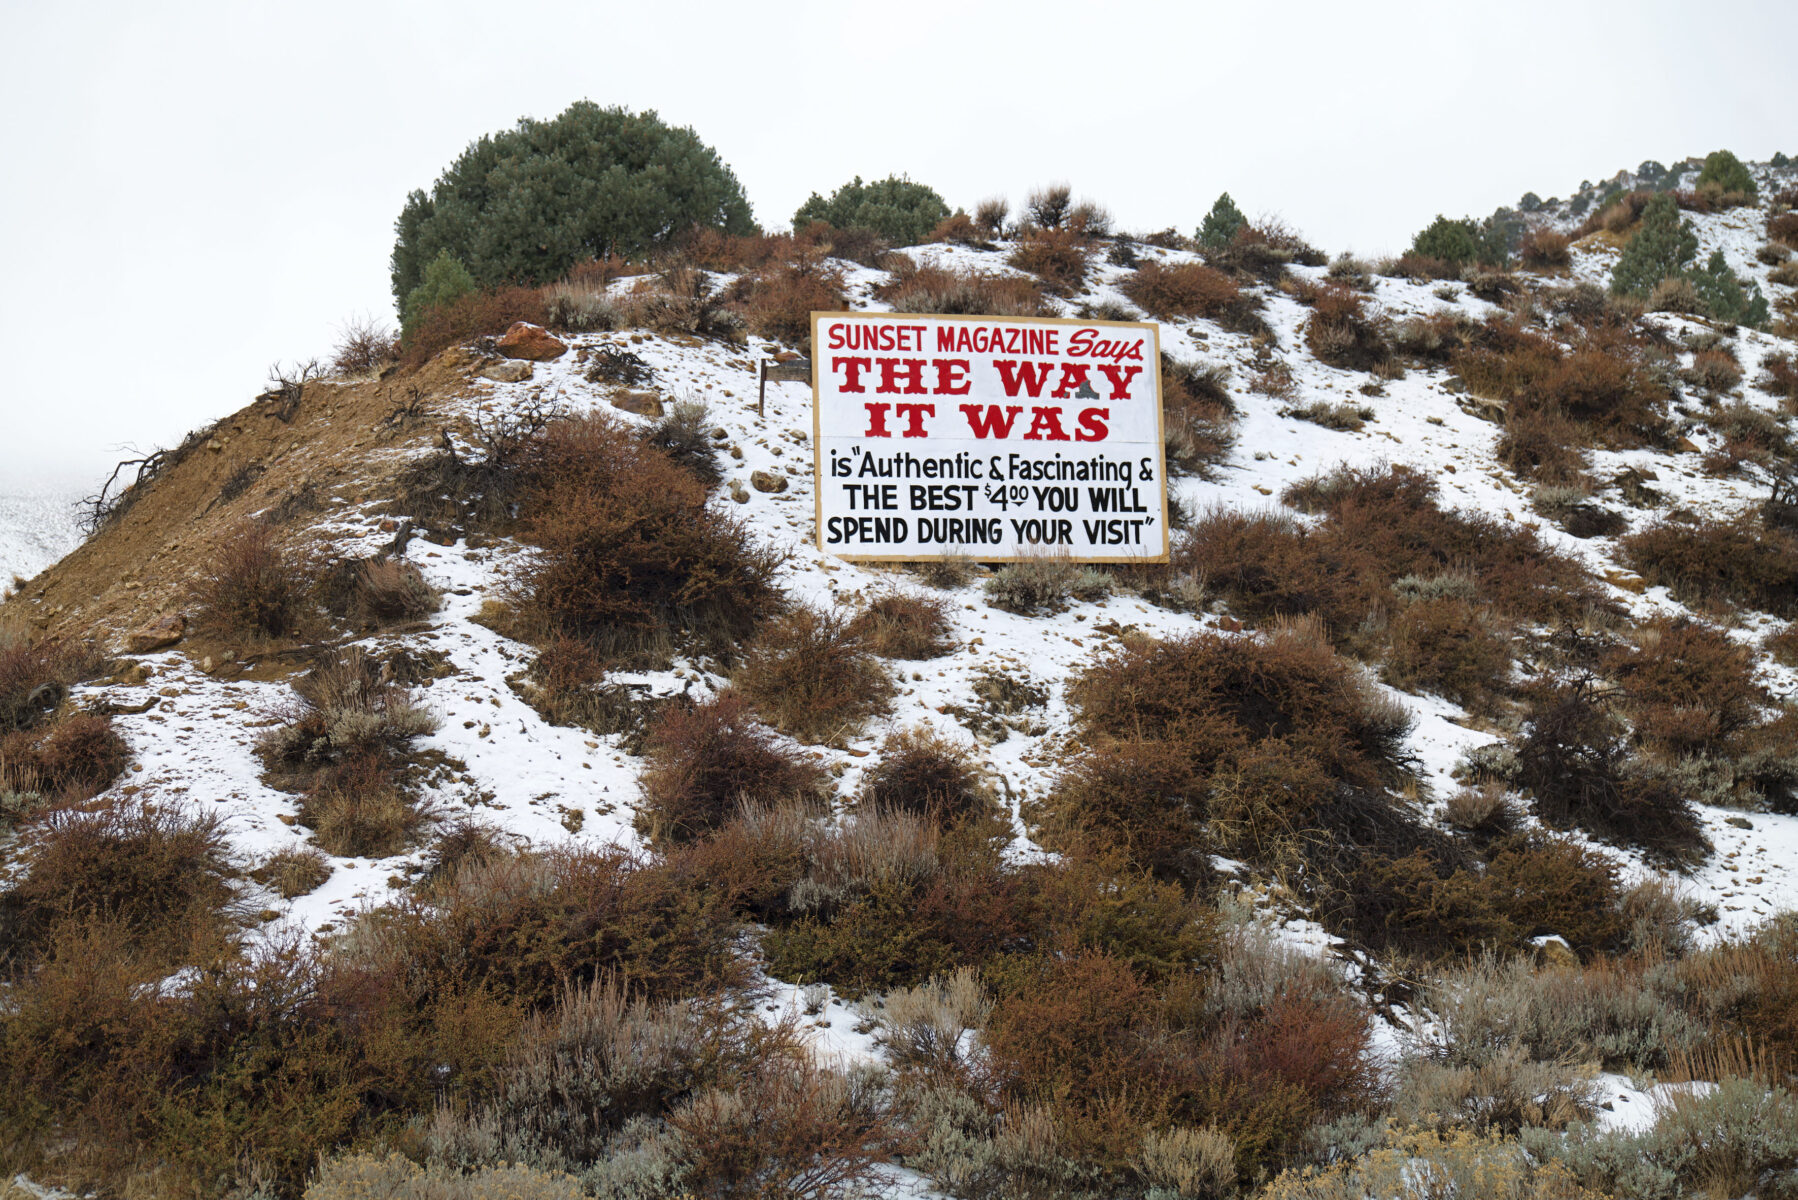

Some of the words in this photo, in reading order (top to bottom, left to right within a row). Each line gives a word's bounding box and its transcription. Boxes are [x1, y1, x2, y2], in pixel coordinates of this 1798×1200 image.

[828, 323, 927, 351] SUNSET
[937, 326, 1059, 355] MAGAZINE
[1066, 328, 1145, 363] Says
[832, 356, 971, 395] THE
[993, 360, 1143, 400] WAY
[865, 402, 935, 438] IT
[959, 404, 1109, 442] WAS
[989, 456, 1004, 481] &
[1009, 453, 1131, 491] Fascinating
[1139, 458, 1153, 481] &
[843, 484, 898, 509] THE
[910, 485, 978, 510] BEST
[1032, 486, 1078, 512] YOU
[1088, 486, 1147, 512] WILL
[827, 517, 908, 543] SPEND
[918, 518, 1002, 544] DURING
[1010, 519, 1073, 545] YOUR
[1083, 516, 1154, 544] VISIT"
